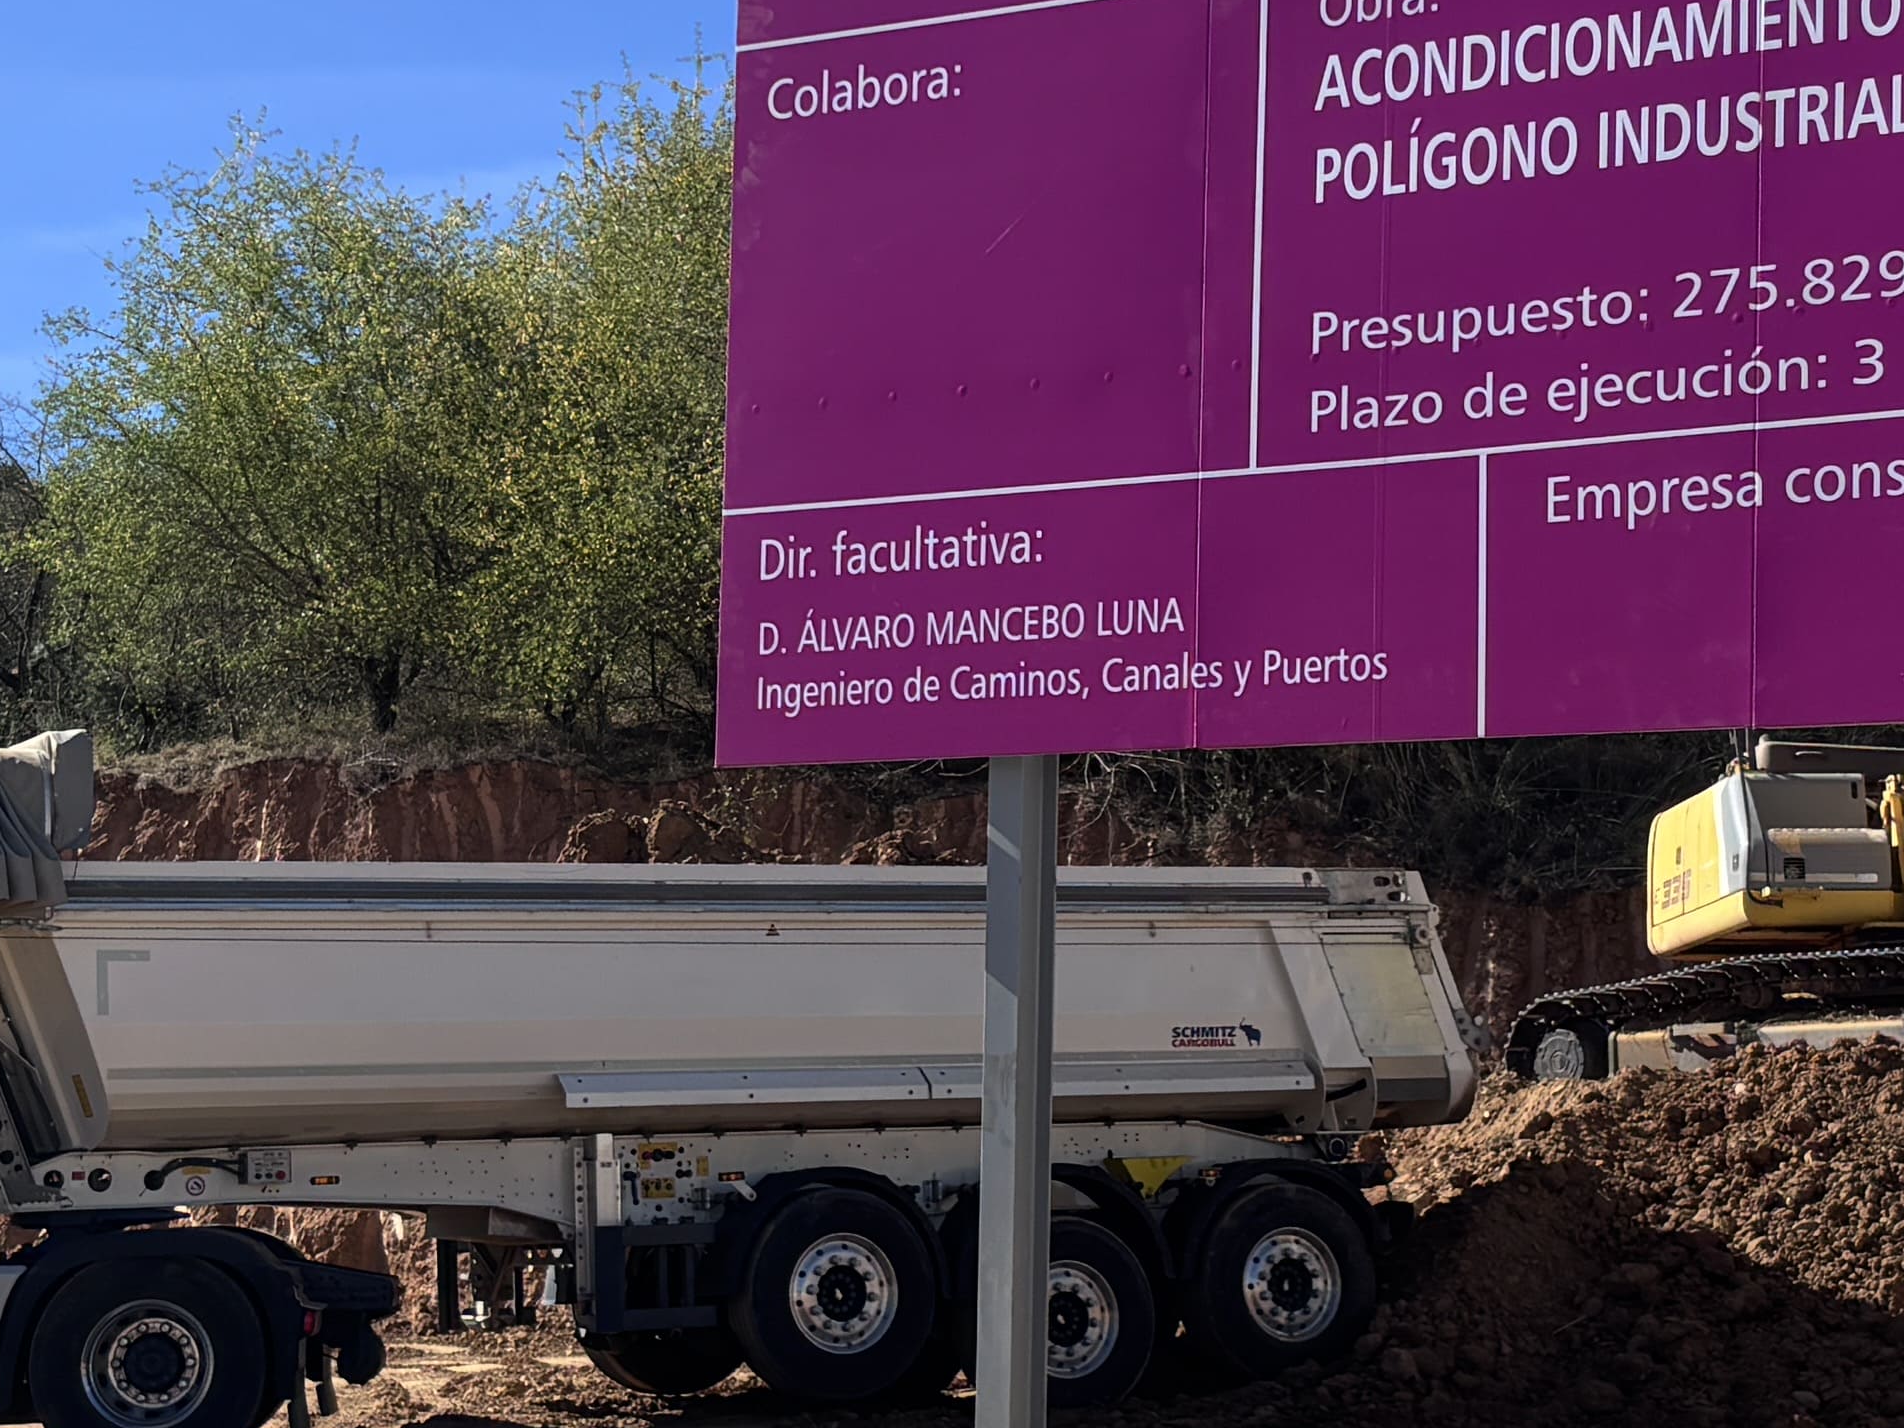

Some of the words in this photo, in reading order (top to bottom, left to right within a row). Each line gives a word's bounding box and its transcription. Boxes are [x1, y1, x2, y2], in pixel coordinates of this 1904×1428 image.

[766, 63, 961, 120] Colabora:
[1314, 115, 1578, 204] POLÍGONO
[1311, 285, 1648, 354] Presupuesto:
[1310, 383, 1443, 433] Plazo
[1463, 370, 1527, 419] de
[1546, 344, 1827, 423] ejecución:
[1852, 337, 1884, 385] 3
[1546, 470, 1762, 528] Empresa
[759, 534, 816, 581] Dir.
[831, 519, 1042, 576] facultativa:
[758, 621, 787, 655] D.
[796, 607, 914, 653] ÁLVARO
[925, 602, 1085, 646] MANCEBO
[1096, 596, 1185, 636] LUNA
[756, 669, 893, 718] Ingeniero
[902, 664, 940, 702] de
[949, 660, 1089, 700] Caminos,
[1100, 650, 1225, 698] Canales
[1232, 659, 1252, 697] y
[1262, 647, 1387, 685] Puertos
[1171, 1026, 1237, 1038] SCHMITZ
